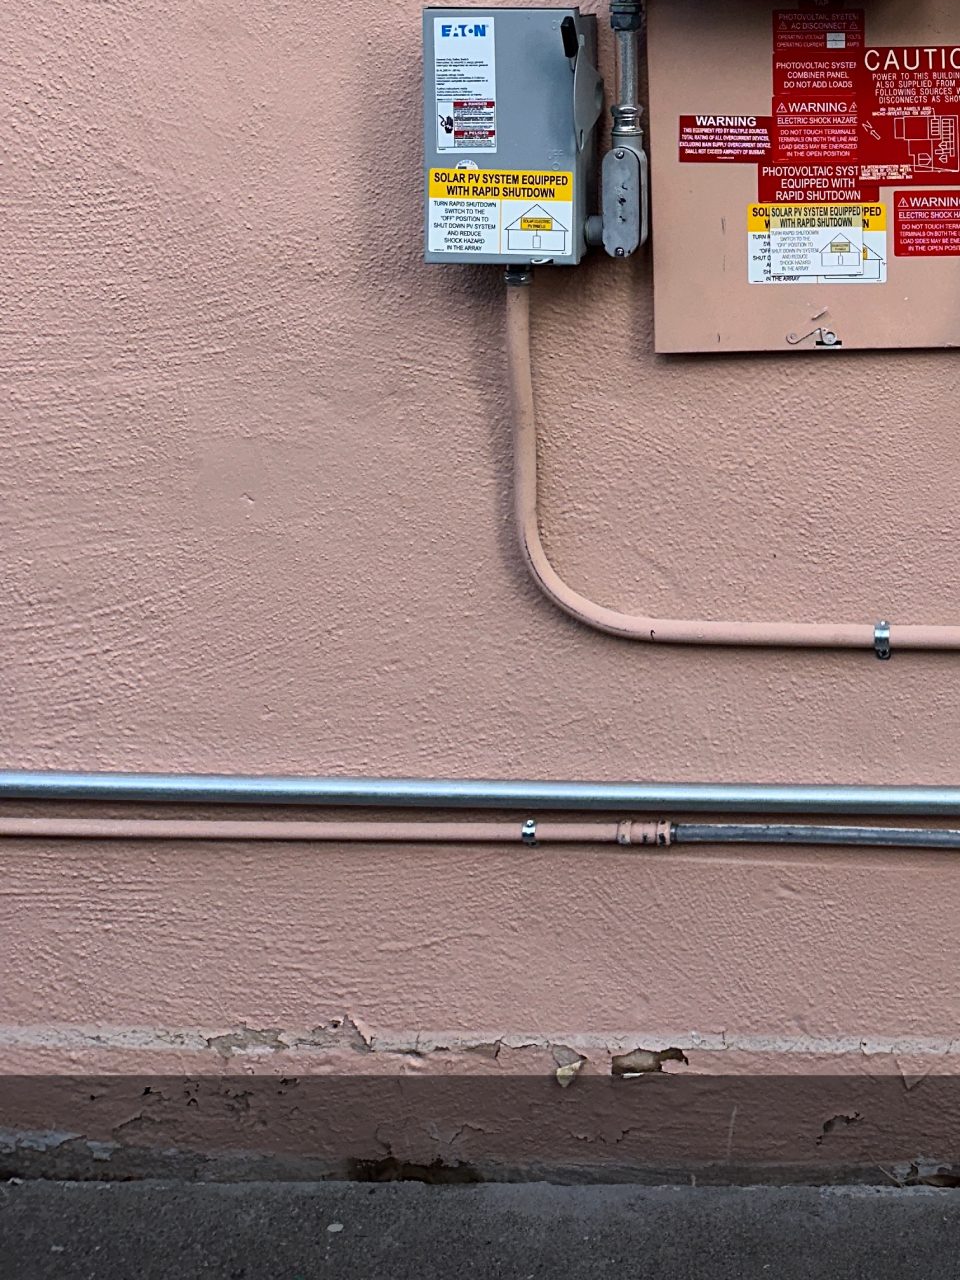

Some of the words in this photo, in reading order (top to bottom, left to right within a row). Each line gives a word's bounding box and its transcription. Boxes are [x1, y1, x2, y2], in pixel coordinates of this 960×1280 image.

[898, 80, 932, 88] SUPPLIED
[879, 96, 927, 104] DISCONNECTS
[788, 102, 847, 112] WARNING
[696, 116, 756, 126] WARNING
[762, 166, 833, 176] PHOTOVOLTAIC
[434, 173, 465, 183] SOLAR
[468, 174, 480, 183] PV
[483, 174, 519, 184] SYSTEM
[522, 175, 568, 185] EQUIPPED
[781, 179, 829, 188] EQUIPPED
[832, 178, 855, 188] WITH
[446, 186, 469, 195] WITH
[472, 187, 500, 197] RAPID
[503, 187, 555, 198] SHUTDOWN
[776, 191, 804, 200] RAPID
[806, 190, 860, 200] SHUTDOWN
[771, 208, 792, 217] SOLAR
[794, 208, 802, 217] PV
[804, 207, 828, 216] SYSTEM
[830, 207, 860, 216] EQUIPPED
[780, 218, 795, 228] WITH
[797, 218, 815, 227] RAPID
[817, 217, 852, 227] SHUTDOWN
